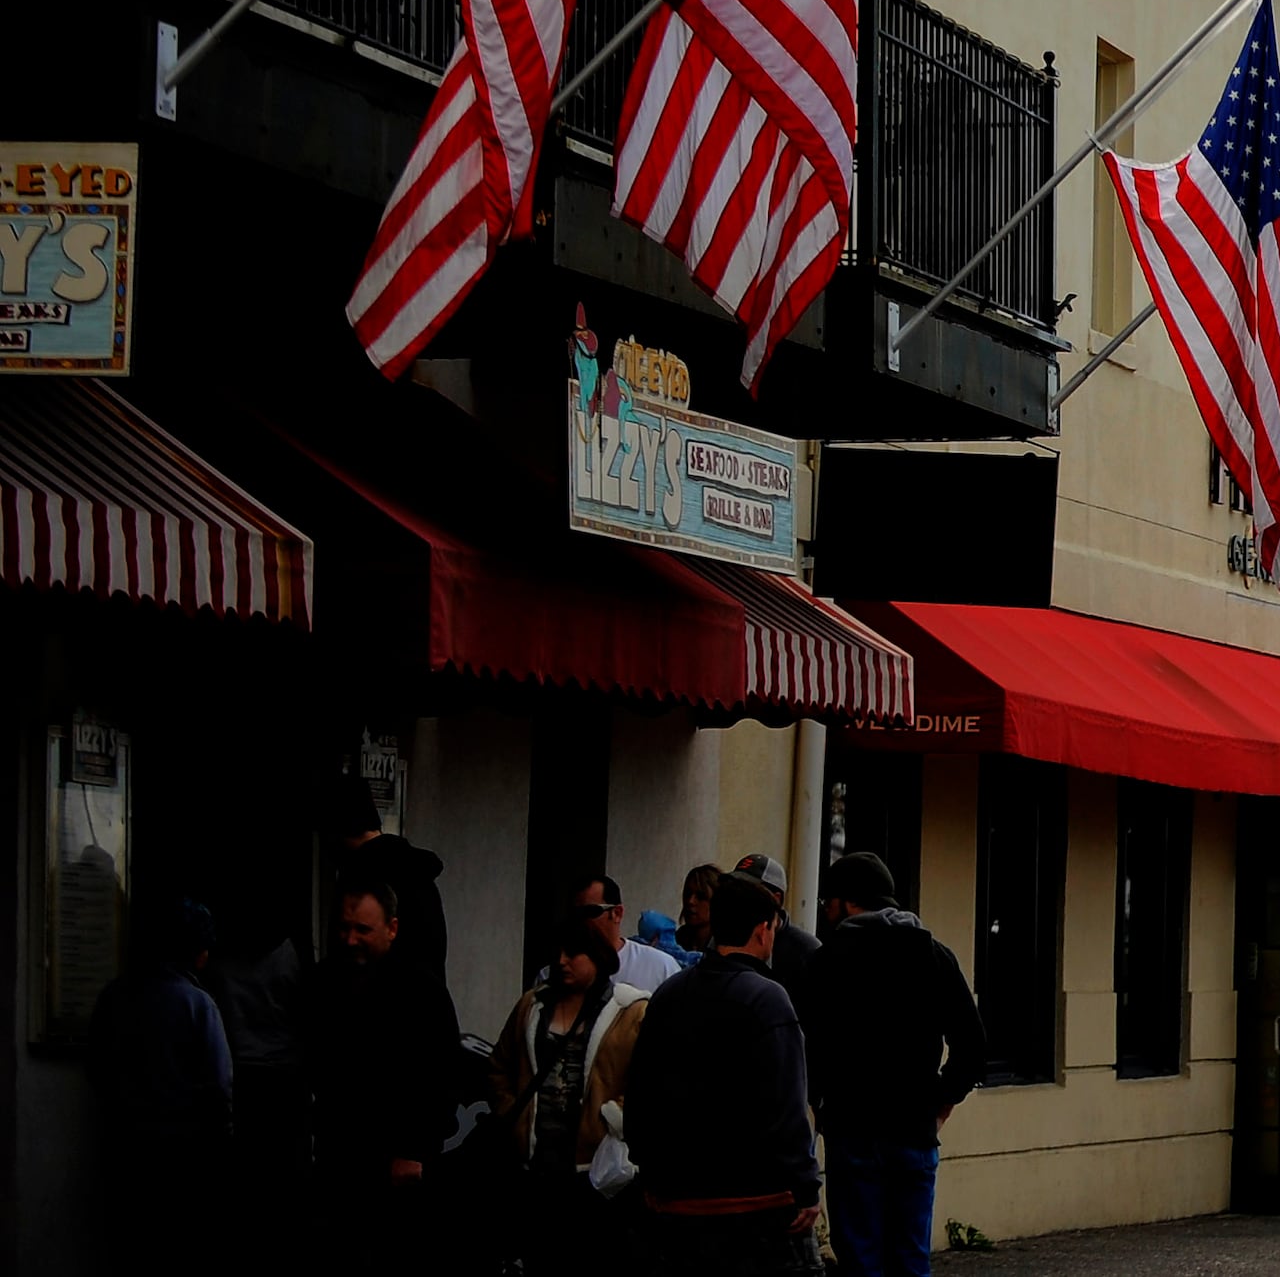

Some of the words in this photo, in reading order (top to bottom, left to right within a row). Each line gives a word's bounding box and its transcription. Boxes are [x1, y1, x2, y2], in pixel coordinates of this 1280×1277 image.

[690, 446, 739, 480] SEAFOOD
[748, 460, 789, 491] STEAKS
[915, 715, 981, 733] DIME
